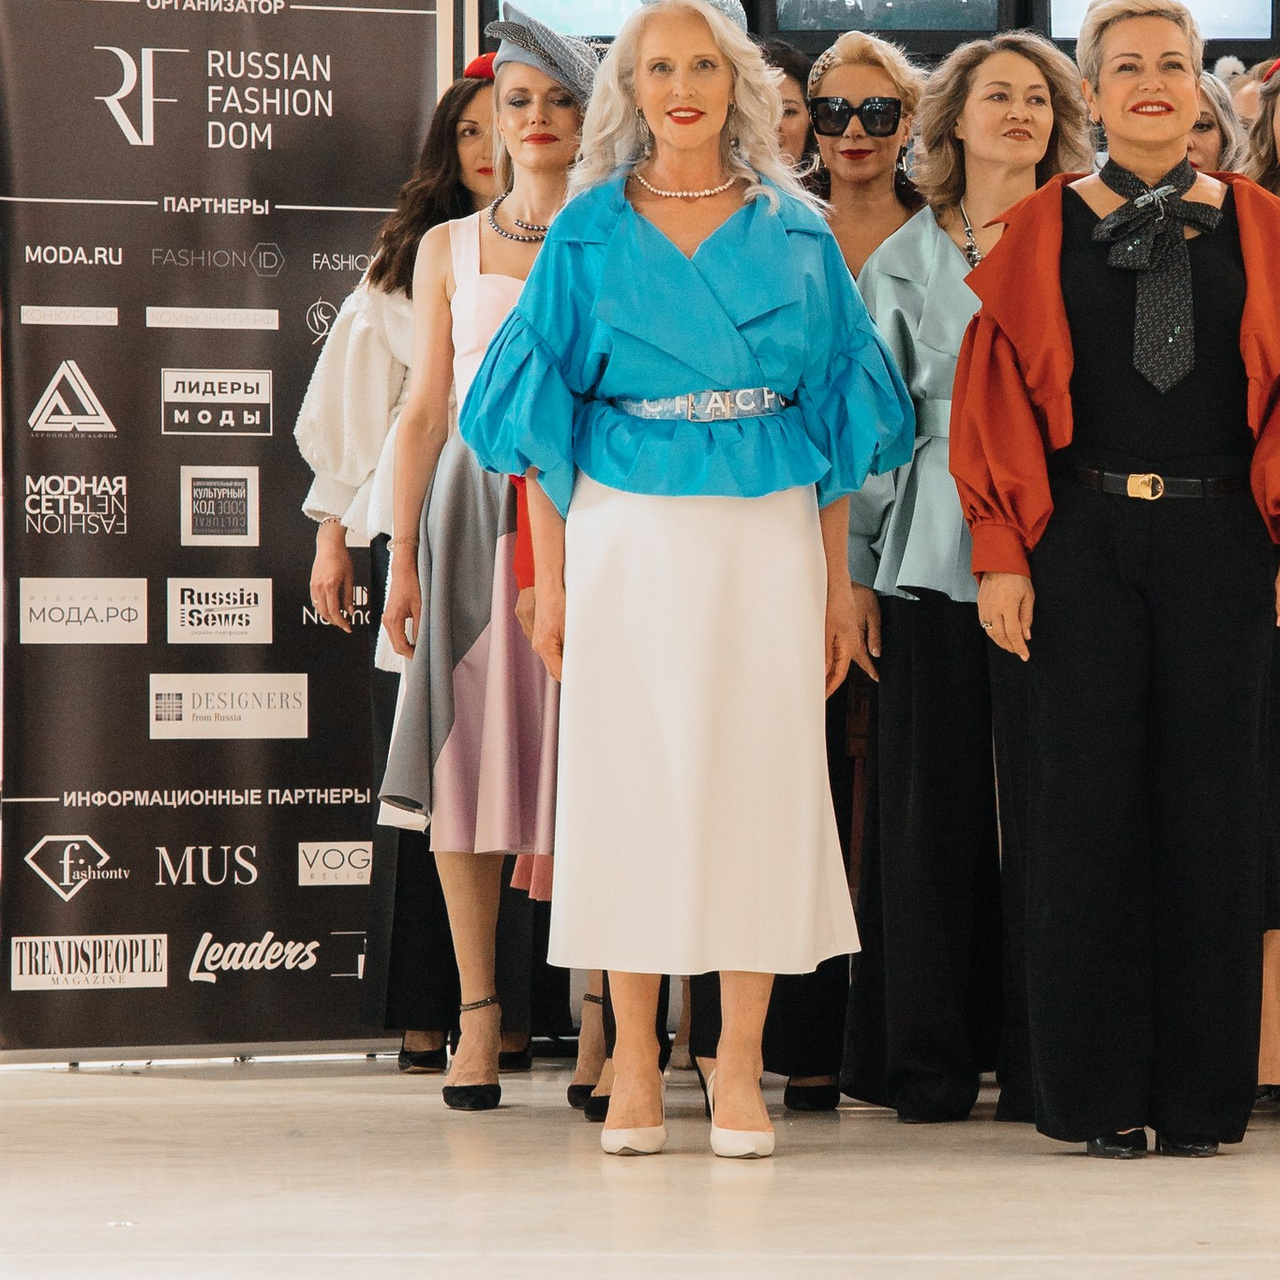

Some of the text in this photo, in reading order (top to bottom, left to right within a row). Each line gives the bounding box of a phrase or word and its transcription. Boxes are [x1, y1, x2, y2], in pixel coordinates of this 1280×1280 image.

[207, 50, 331, 81] RUSSIAN
[207, 86, 333, 117] FASHION
[207, 121, 272, 150] DOM
[163, 197, 270, 215] ПАРТНЕРЫ
[25, 246, 123, 265] MODA.RU
[151, 248, 247, 267] FASHION
[313, 253, 372, 271] FASHIO
[173, 380, 260, 397] ЛИДЕРЫ
[173, 408, 261, 427] МОДЫ
[193, 487, 246, 499] КУЛЬТУРНЫЙ
[25, 494, 84, 515] СЕТЬ
[193, 500, 216, 515] КОД
[180, 587, 260, 606] Russia
[29, 606, 139, 626] МОДА.РФ
[187, 608, 252, 627] Sews
[191, 691, 304, 710] DESIGNERS
[192, 712, 242, 722] from Russia
[63, 788, 371, 808] ИНФОРМАЦИОННЫЕ ПАРТНЕРЫ
[155, 845, 259, 886] MUS
[302, 849, 370, 869] VOG
[310, 872, 365, 880] RELIG
[15, 938, 163, 976] TRENDSPEOPLE
[189, 931, 320, 983] Leaders
[51, 975, 126, 985] MAGAZINE
